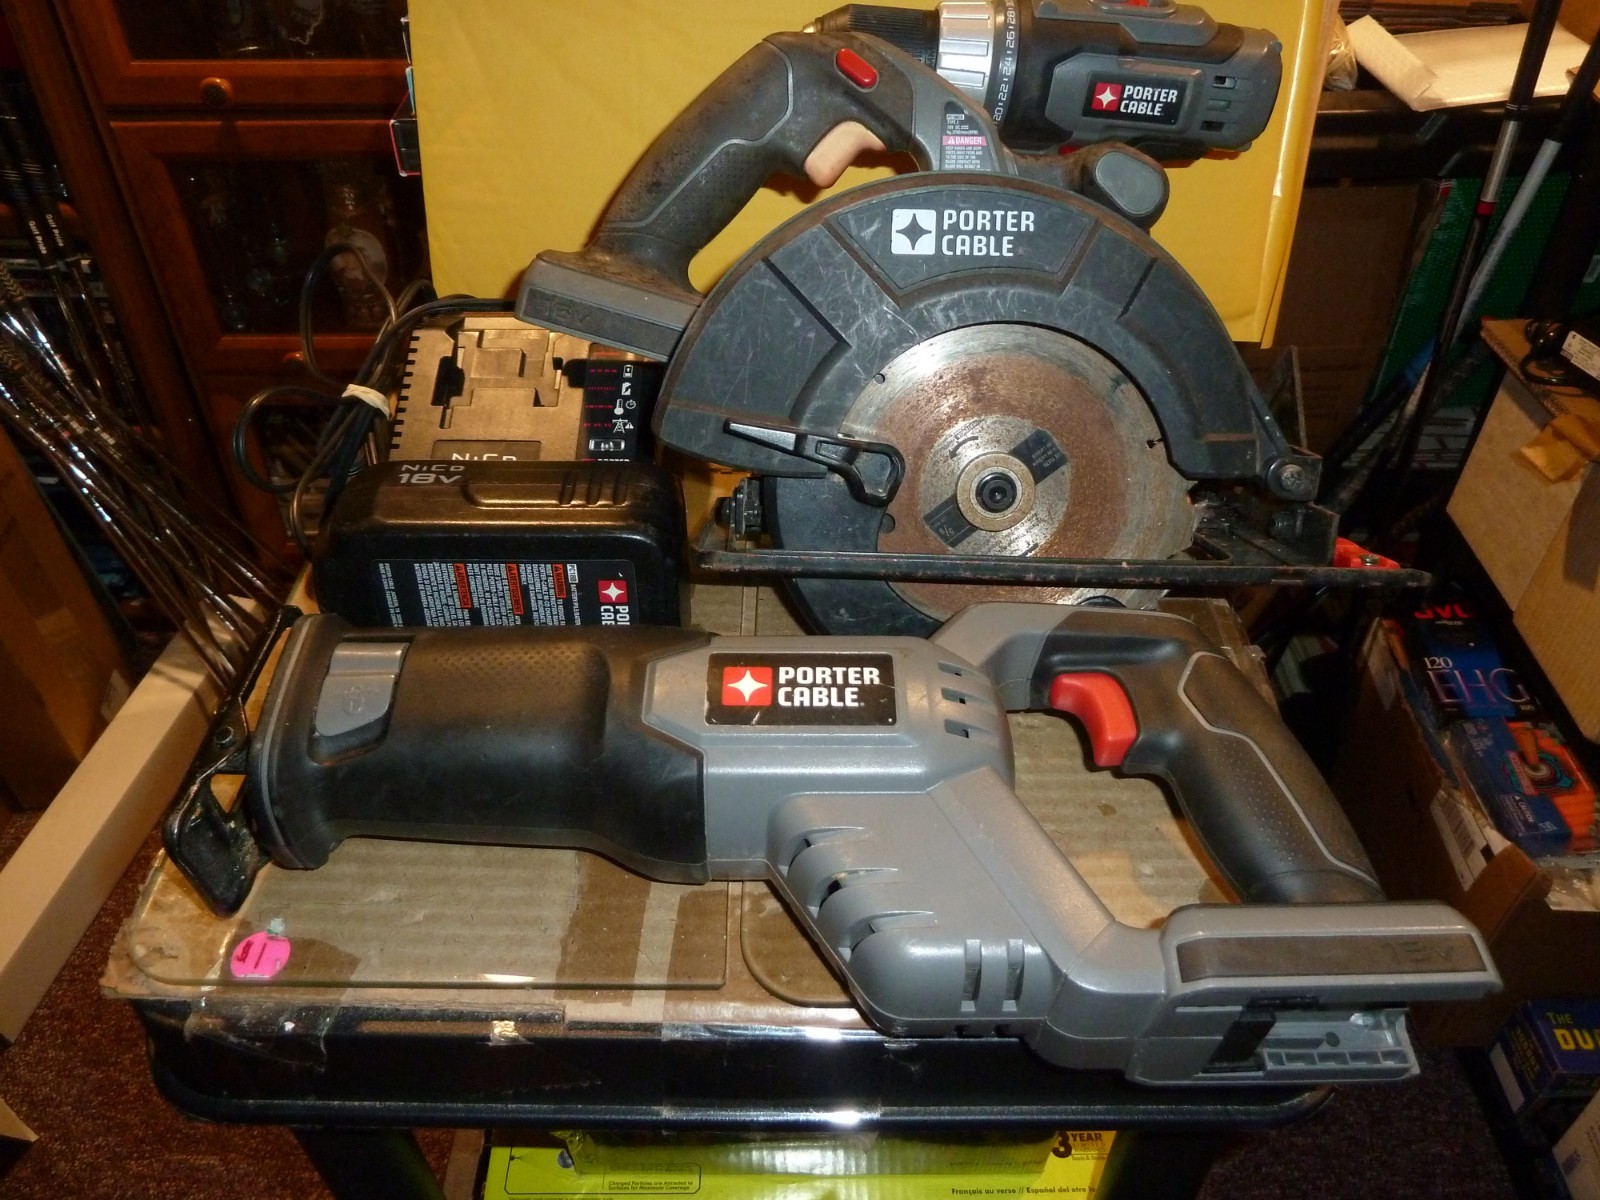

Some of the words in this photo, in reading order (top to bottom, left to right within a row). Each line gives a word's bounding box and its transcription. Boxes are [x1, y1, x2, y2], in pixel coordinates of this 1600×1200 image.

[1005, 31, 1016, 49] 26
[1002, 56, 1013, 76] 24
[998, 83, 1009, 101] 22
[1123, 85, 1178, 103] PORTER
[993, 107, 1004, 122] 20
[1120, 100, 1164, 116] CABLE
[955, 136, 982, 145] DANGER
[943, 209, 1035, 232] PORTER
[942, 235, 1014, 257] CABLE
[398, 473, 462, 484] 18V
[1424, 656, 1453, 669] 120
[778, 666, 880, 685] PORTER
[1426, 667, 1532, 704] EHG
[777, 686, 860, 707] CABLE
[1545, 1011, 1575, 1027] THE
[1051, 1131, 1073, 1159] 3
[1070, 1132, 1103, 1142] YEAR
[951, 1188, 982, 1196] Français
[1026, 1186, 1056, 1195] Español
